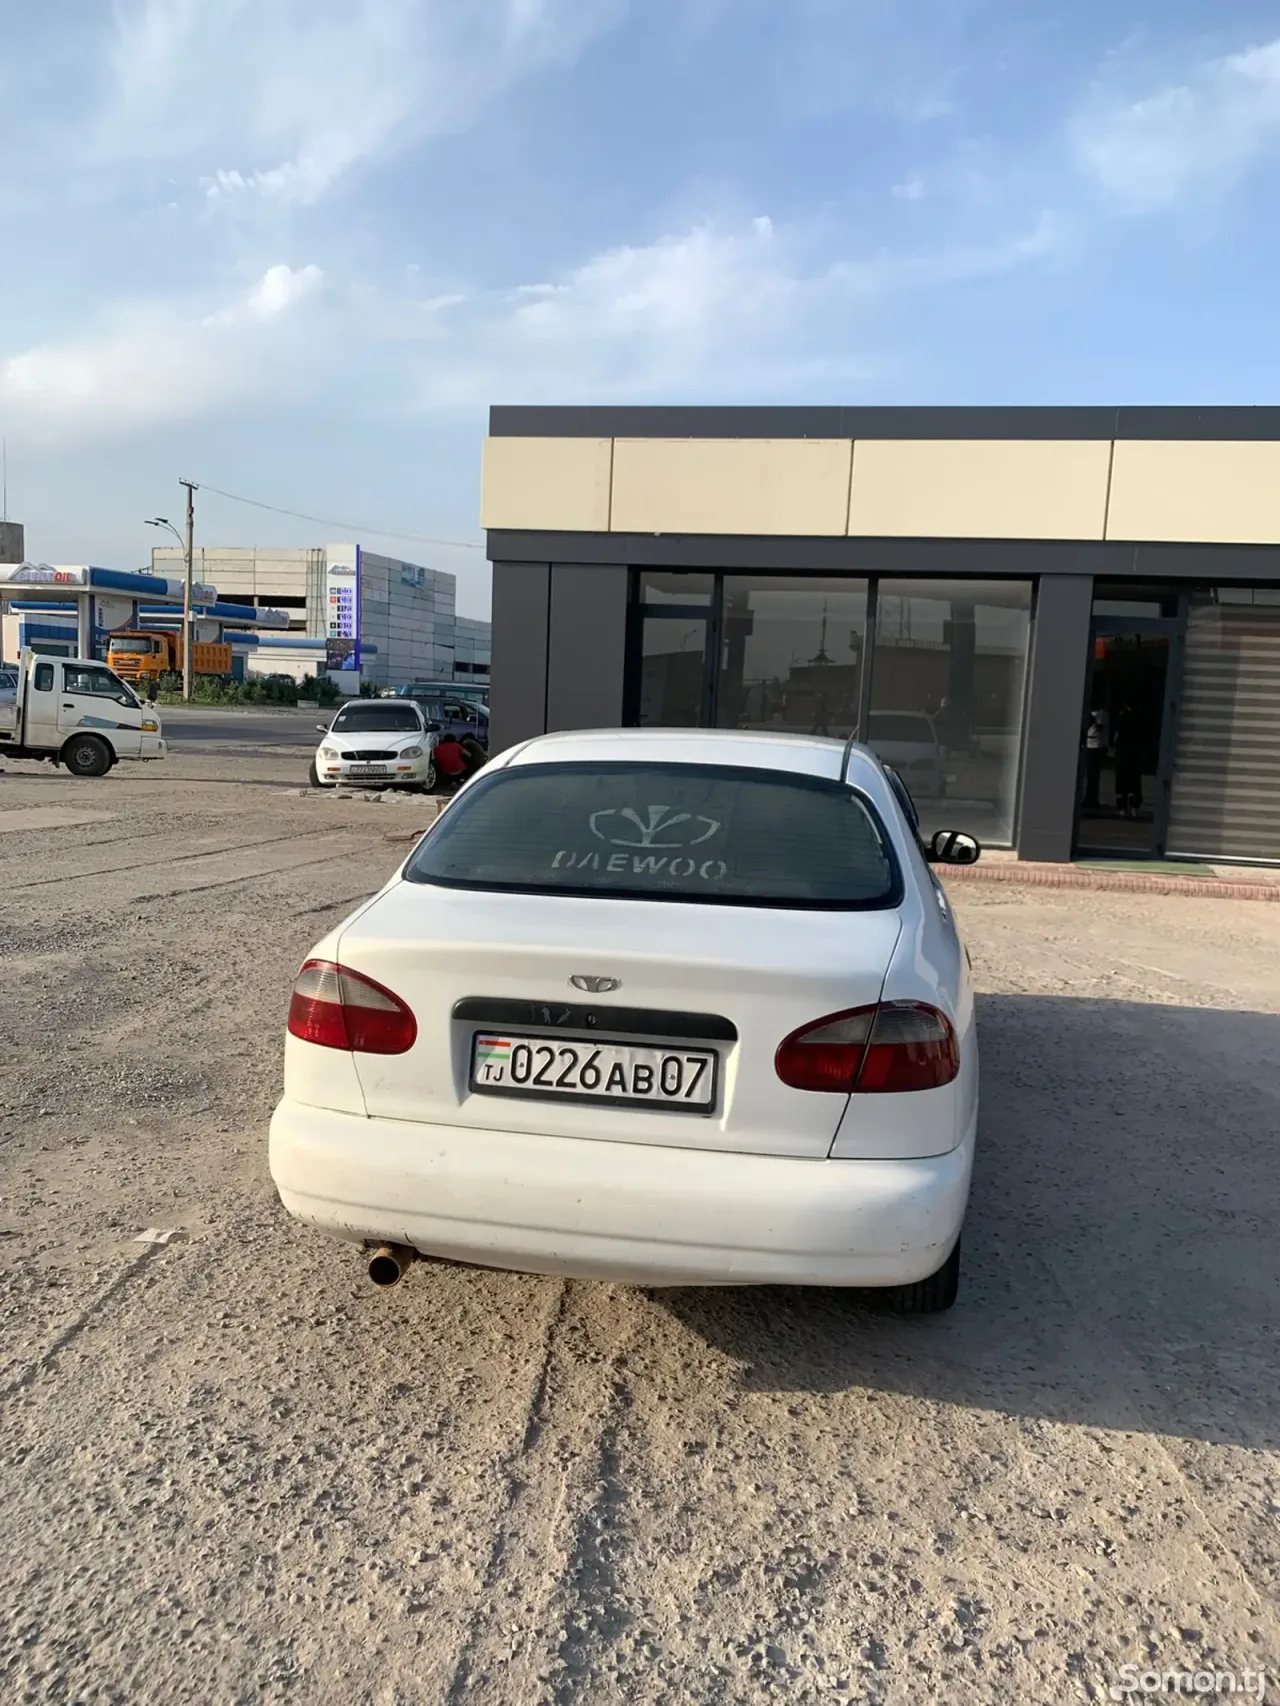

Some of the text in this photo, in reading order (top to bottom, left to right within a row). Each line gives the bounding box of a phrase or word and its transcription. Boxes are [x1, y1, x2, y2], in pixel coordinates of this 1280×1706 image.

[54, 572, 71, 582] OIL
[551, 851, 727, 880] DAEWOO
[484, 1044, 708, 1098] TJ 0226AB07
